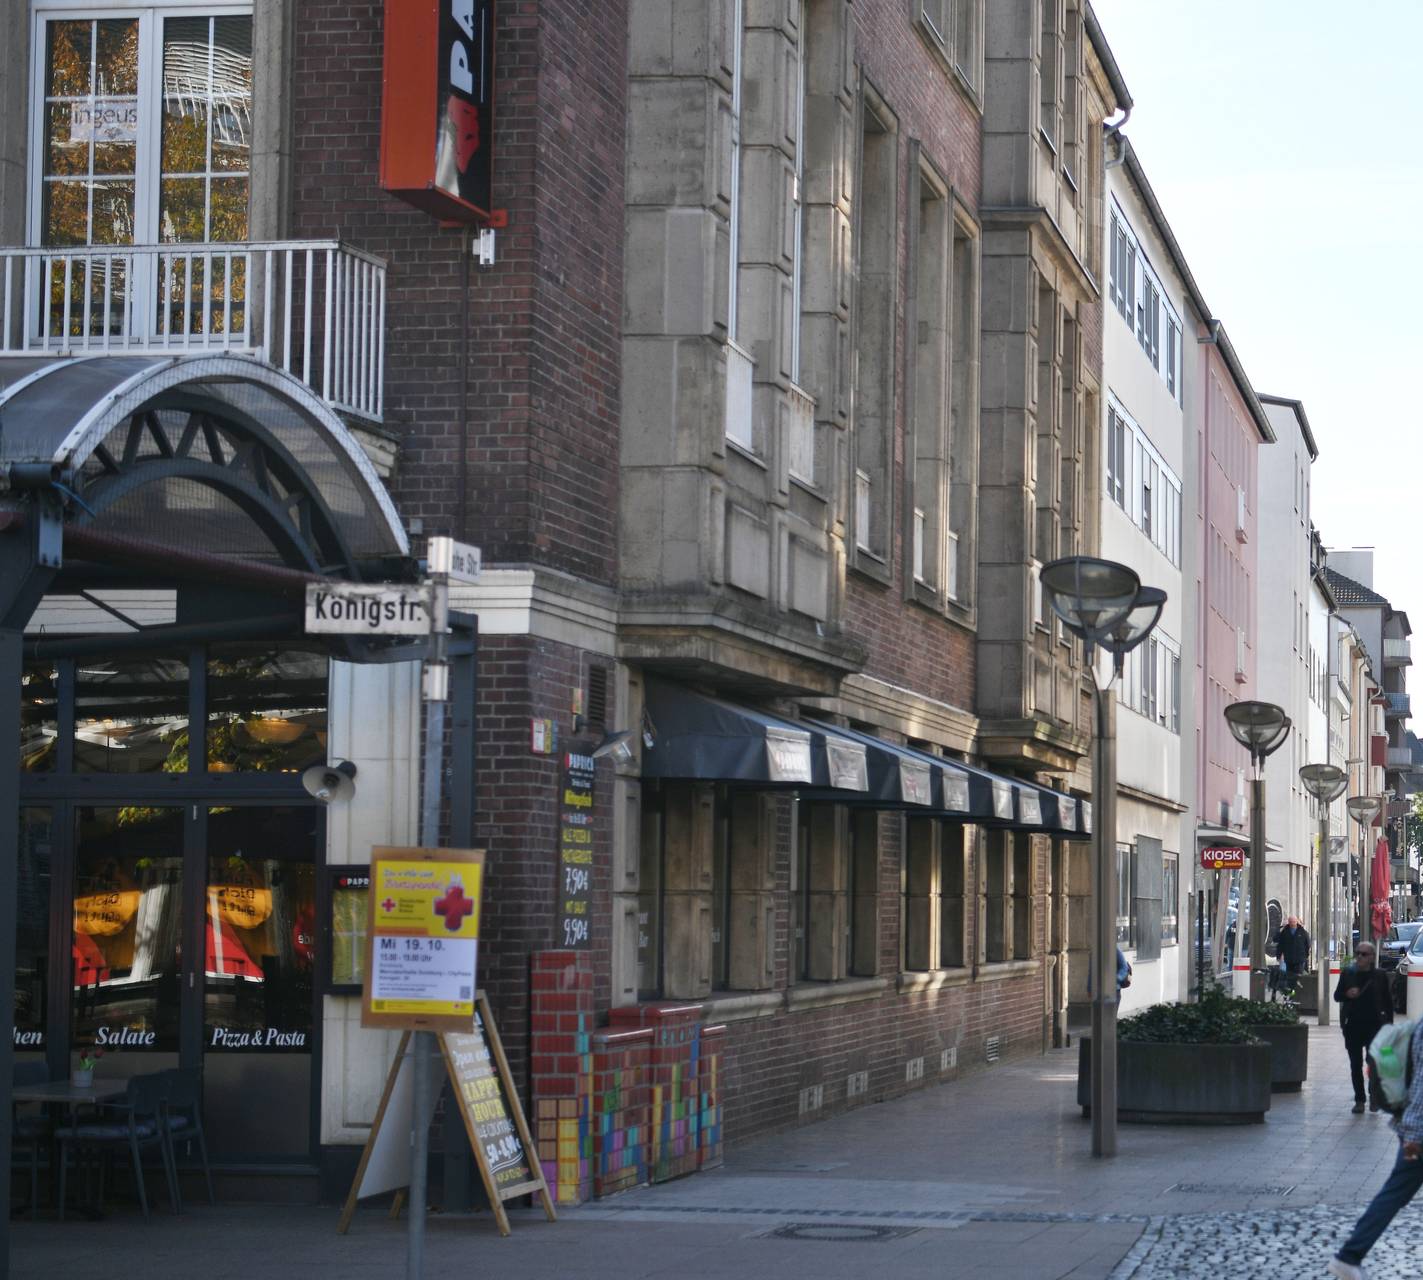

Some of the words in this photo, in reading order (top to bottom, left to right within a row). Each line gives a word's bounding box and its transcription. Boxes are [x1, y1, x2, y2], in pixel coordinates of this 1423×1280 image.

[74, 106, 137, 128] ingeus
[466, 553, 478, 577] Str.
[315, 592, 422, 628] Königstr.
[1203, 850, 1241, 861] KIOSK
[381, 938, 397, 950] Mi
[405, 939, 424, 951] 19.
[428, 940, 446, 951] 10.
[95, 1026, 156, 1045] Salate
[211, 1027, 249, 1048] Pizza
[251, 1029, 262, 1045] &
[265, 1027, 306, 1046] Pasta
